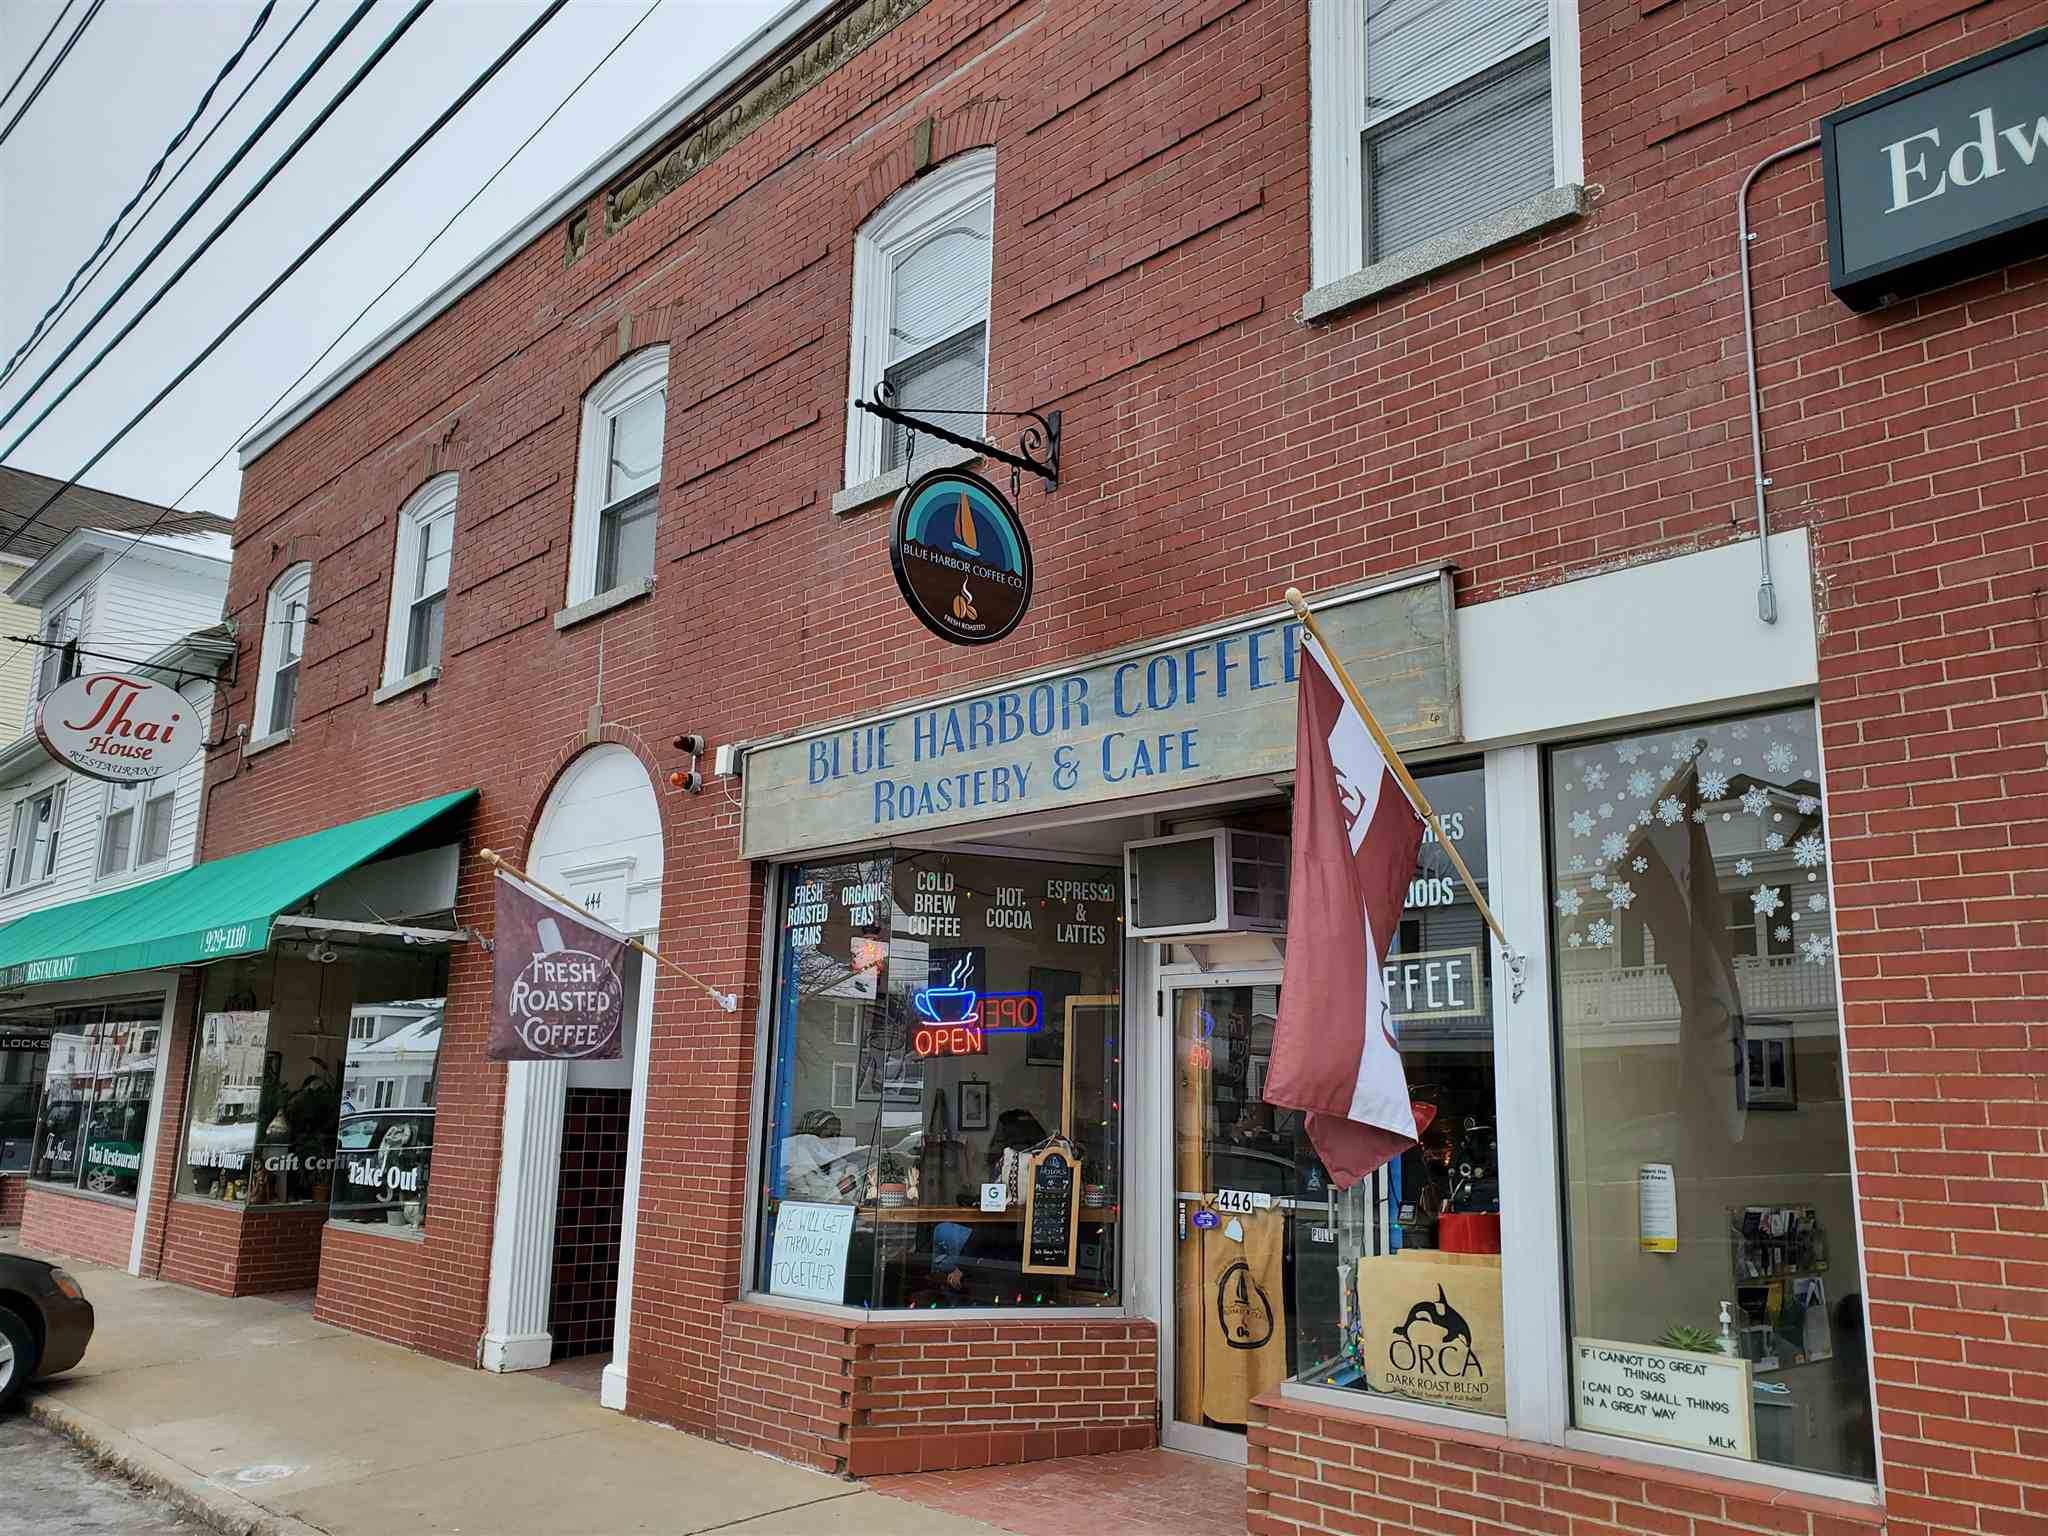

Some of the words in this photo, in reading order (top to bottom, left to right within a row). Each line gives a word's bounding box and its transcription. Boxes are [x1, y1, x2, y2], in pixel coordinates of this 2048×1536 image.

[903, 543, 928, 560] BLUE
[930, 551, 971, 574] HARBOR
[972, 565, 1006, 584] COFFEE
[1007, 576, 1025, 590] CO.
[943, 613, 962, 629] FRESH
[961, 622, 986, 632] ROASTED
[63, 676, 180, 744] Thai
[808, 721, 897, 785] BLUE
[913, 676, 1089, 763] HARBOR
[1113, 622, 1302, 719] COFFEE
[86, 735, 153, 760] House
[1052, 745, 1081, 791] &
[1102, 728, 1200, 783] CAFE
[69, 750, 162, 777] RESTAURANT
[794, 882, 823, 905] FRESH
[841, 881, 885, 906] ORGANIC
[917, 871, 954, 892] COLD
[1047, 879, 1115, 902] ESPRESSO
[914, 893, 957, 914] BREW
[996, 887, 1024, 907] HOT
[787, 903, 829, 928] ROASTED
[850, 904, 875, 927] TEAS
[986, 908, 1033, 929] COCOA
[1075, 903, 1087, 922] &
[791, 926, 822, 947] BEANS
[908, 915, 961, 937] COFFEE
[1056, 923, 1105, 945] LATTES
[531, 952, 597, 984] FRESH
[510, 981, 611, 1018] ROASTED
[522, 1016, 602, 1048] COFFEE
[915, 1027, 981, 1055] OPEN
[88, 1143, 103, 1164] Thai
[102, 1148, 140, 1170] Restaurant
[187, 1144, 209, 1166] Lunch
[217, 1151, 245, 1170] Dinner
[264, 1153, 299, 1171] Gift
[348, 1158, 385, 1188] Take
[387, 1166, 417, 1192] Out
[1220, 1191, 1251, 1211] 446
[773, 1261, 836, 1290] TOGETHER
[1389, 1339, 1483, 1377] ORCA
[1580, 1348, 1591, 1359] IF
[1598, 1351, 1644, 1367] CANNOT
[1647, 1357, 1666, 1370] DO
[1668, 1360, 1708, 1377] GREAT
[1385, 1372, 1415, 1387] DARK
[1417, 1378, 1450, 1392] ROAST
[1453, 1382, 1488, 1394] BLEND
[1623, 1366, 1667, 1384] THINGS
[1588, 1381, 1612, 1395] CAN
[1616, 1385, 1634, 1398] DO
[1639, 1389, 1681, 1407] SMALL
[1583, 1395, 1595, 1406] IN
[1599, 1398, 1608, 1409] A
[1610, 1399, 1648, 1417] GREAT
[1651, 1407, 1677, 1420] WAY
[1708, 1434, 1737, 1450] MLK
